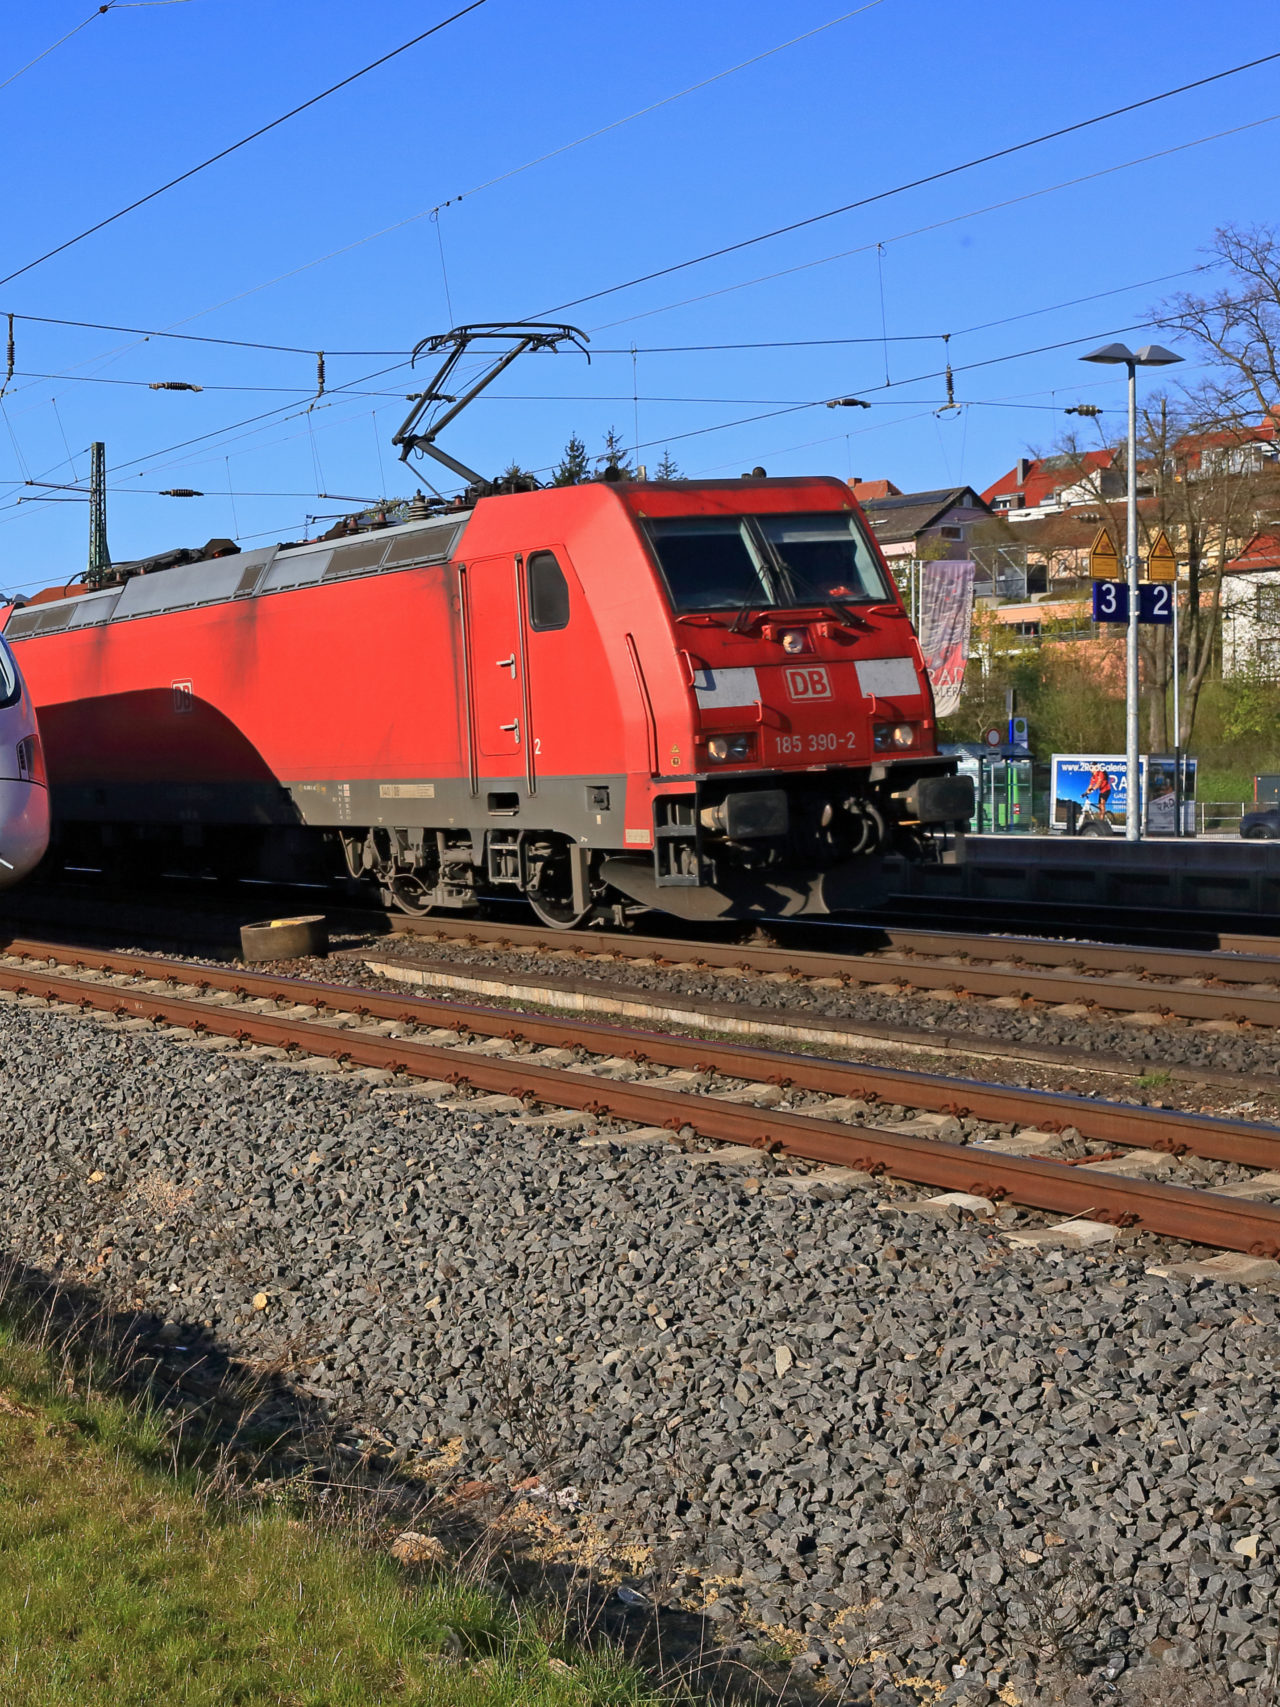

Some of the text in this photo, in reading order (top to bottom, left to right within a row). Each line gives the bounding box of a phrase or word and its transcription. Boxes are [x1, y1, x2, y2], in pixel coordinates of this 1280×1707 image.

[1101, 583, 1117, 613] 3
[1153, 586, 1168, 615] 2
[789, 670, 828, 696] DB
[174, 684, 191, 710] DB
[534, 738, 541, 755] 2
[776, 731, 856, 754] 185 390-2
[1061, 761, 1127, 773] www.2RadGalerie
[1109, 774, 1127, 791] RA
